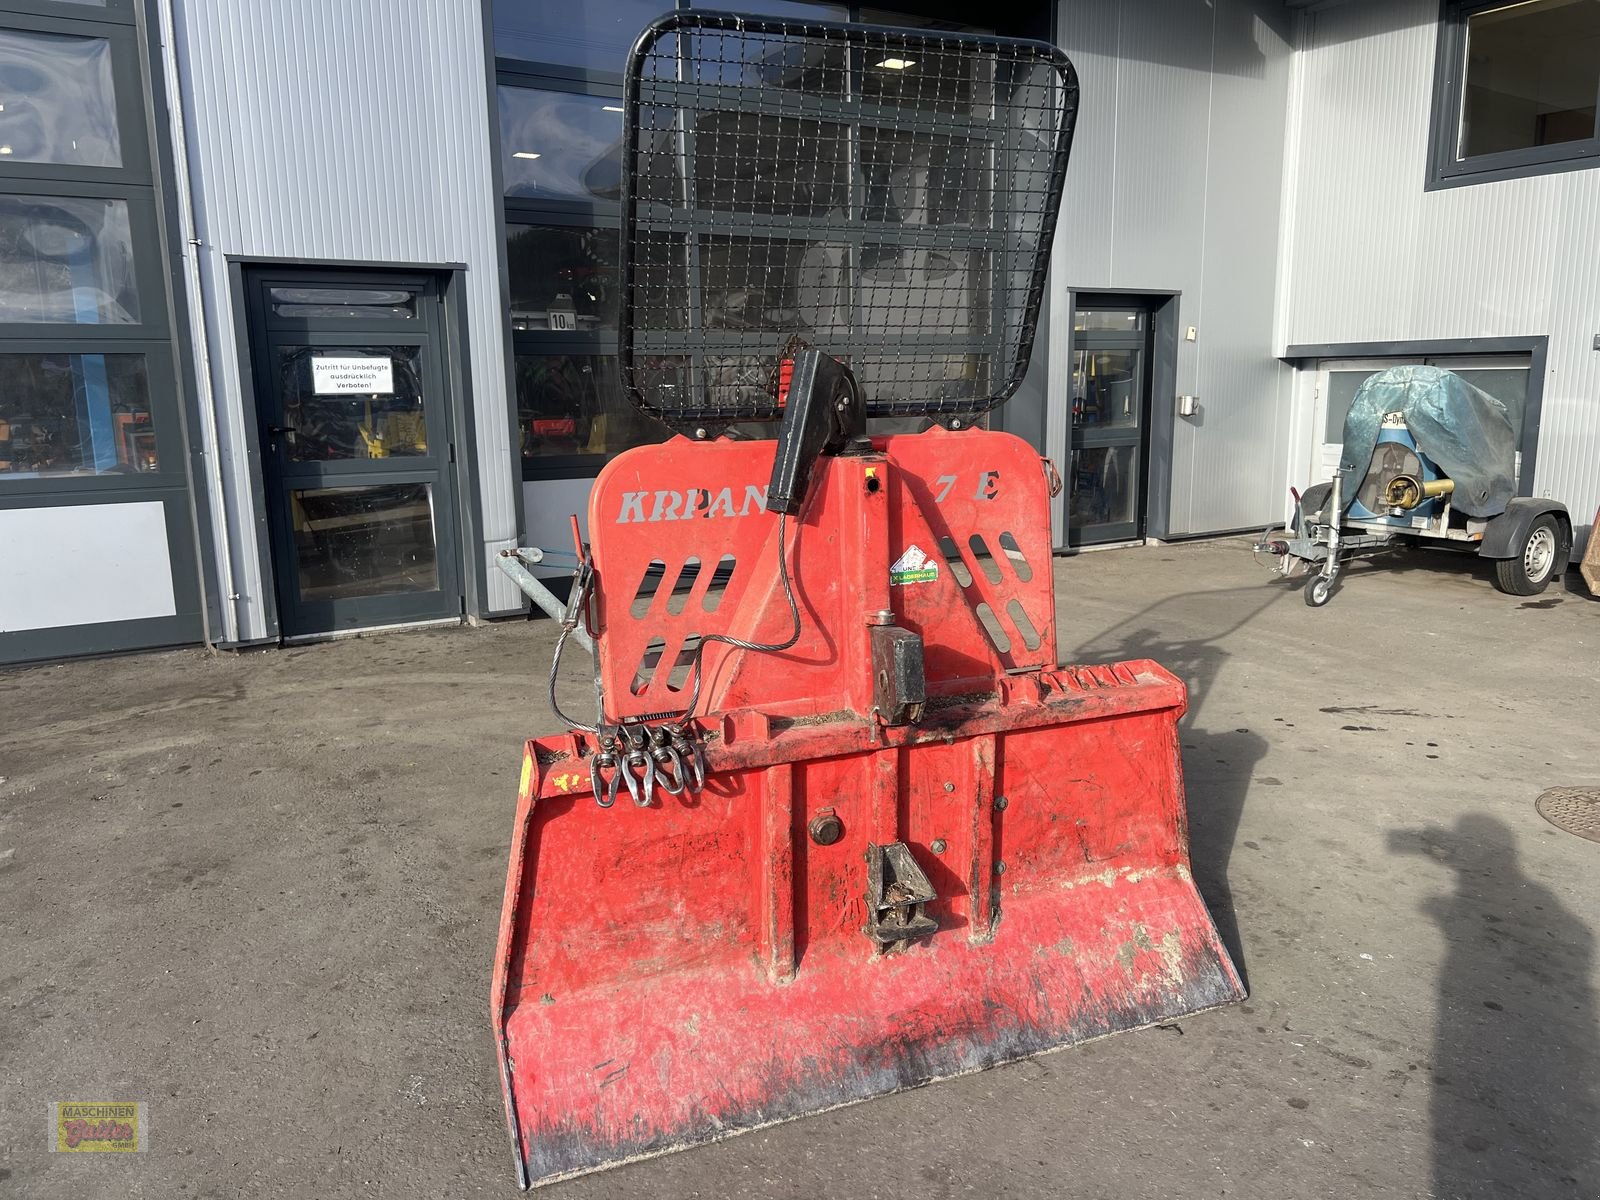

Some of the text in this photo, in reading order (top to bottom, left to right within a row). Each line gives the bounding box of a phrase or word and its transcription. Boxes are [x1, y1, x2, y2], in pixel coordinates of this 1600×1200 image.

[552, 314, 566, 329] 10
[352, 364, 388, 372] Unbefugte
[616, 470, 1000, 524] KRPAN 7 E
